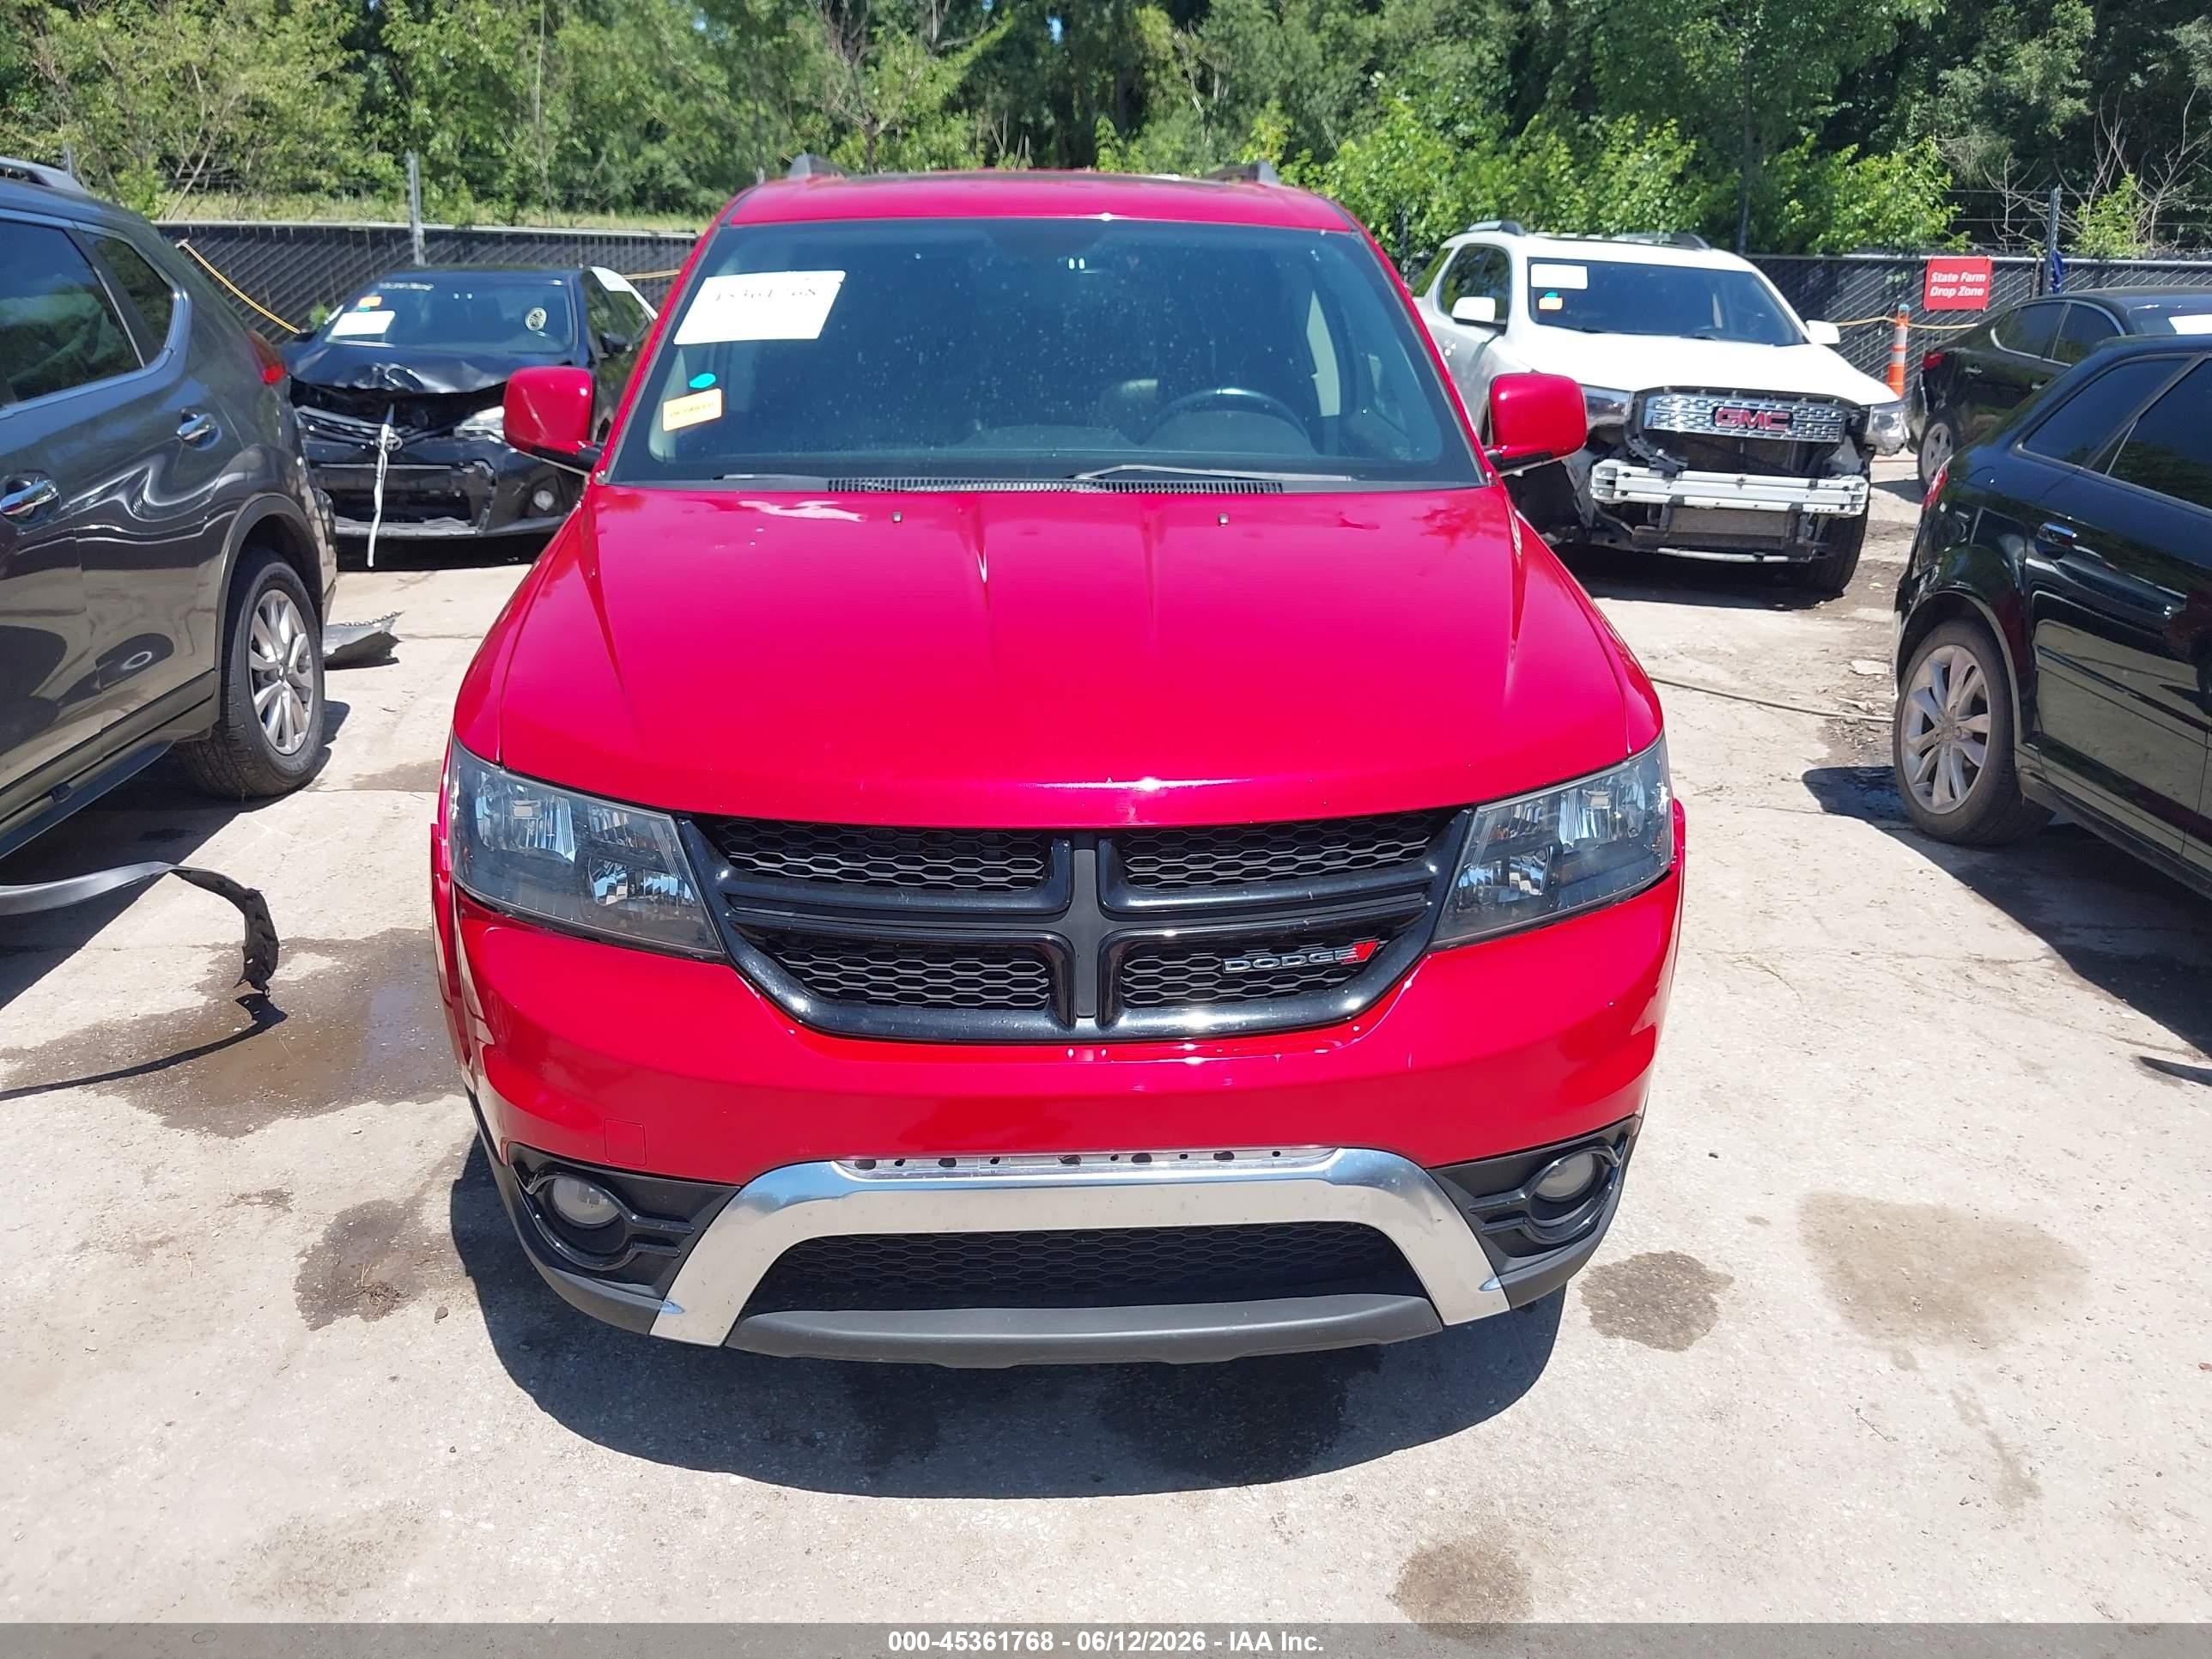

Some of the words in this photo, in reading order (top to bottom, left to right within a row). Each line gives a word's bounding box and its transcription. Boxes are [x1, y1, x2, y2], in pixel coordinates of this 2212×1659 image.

[1930, 270, 1959, 283] State
[1960, 270, 1987, 283] Farm
[1929, 286, 1957, 299] Drop
[1957, 286, 1984, 297] Zone
[1714, 406, 1790, 433] GMC
[1224, 947, 1358, 972] DODGE
